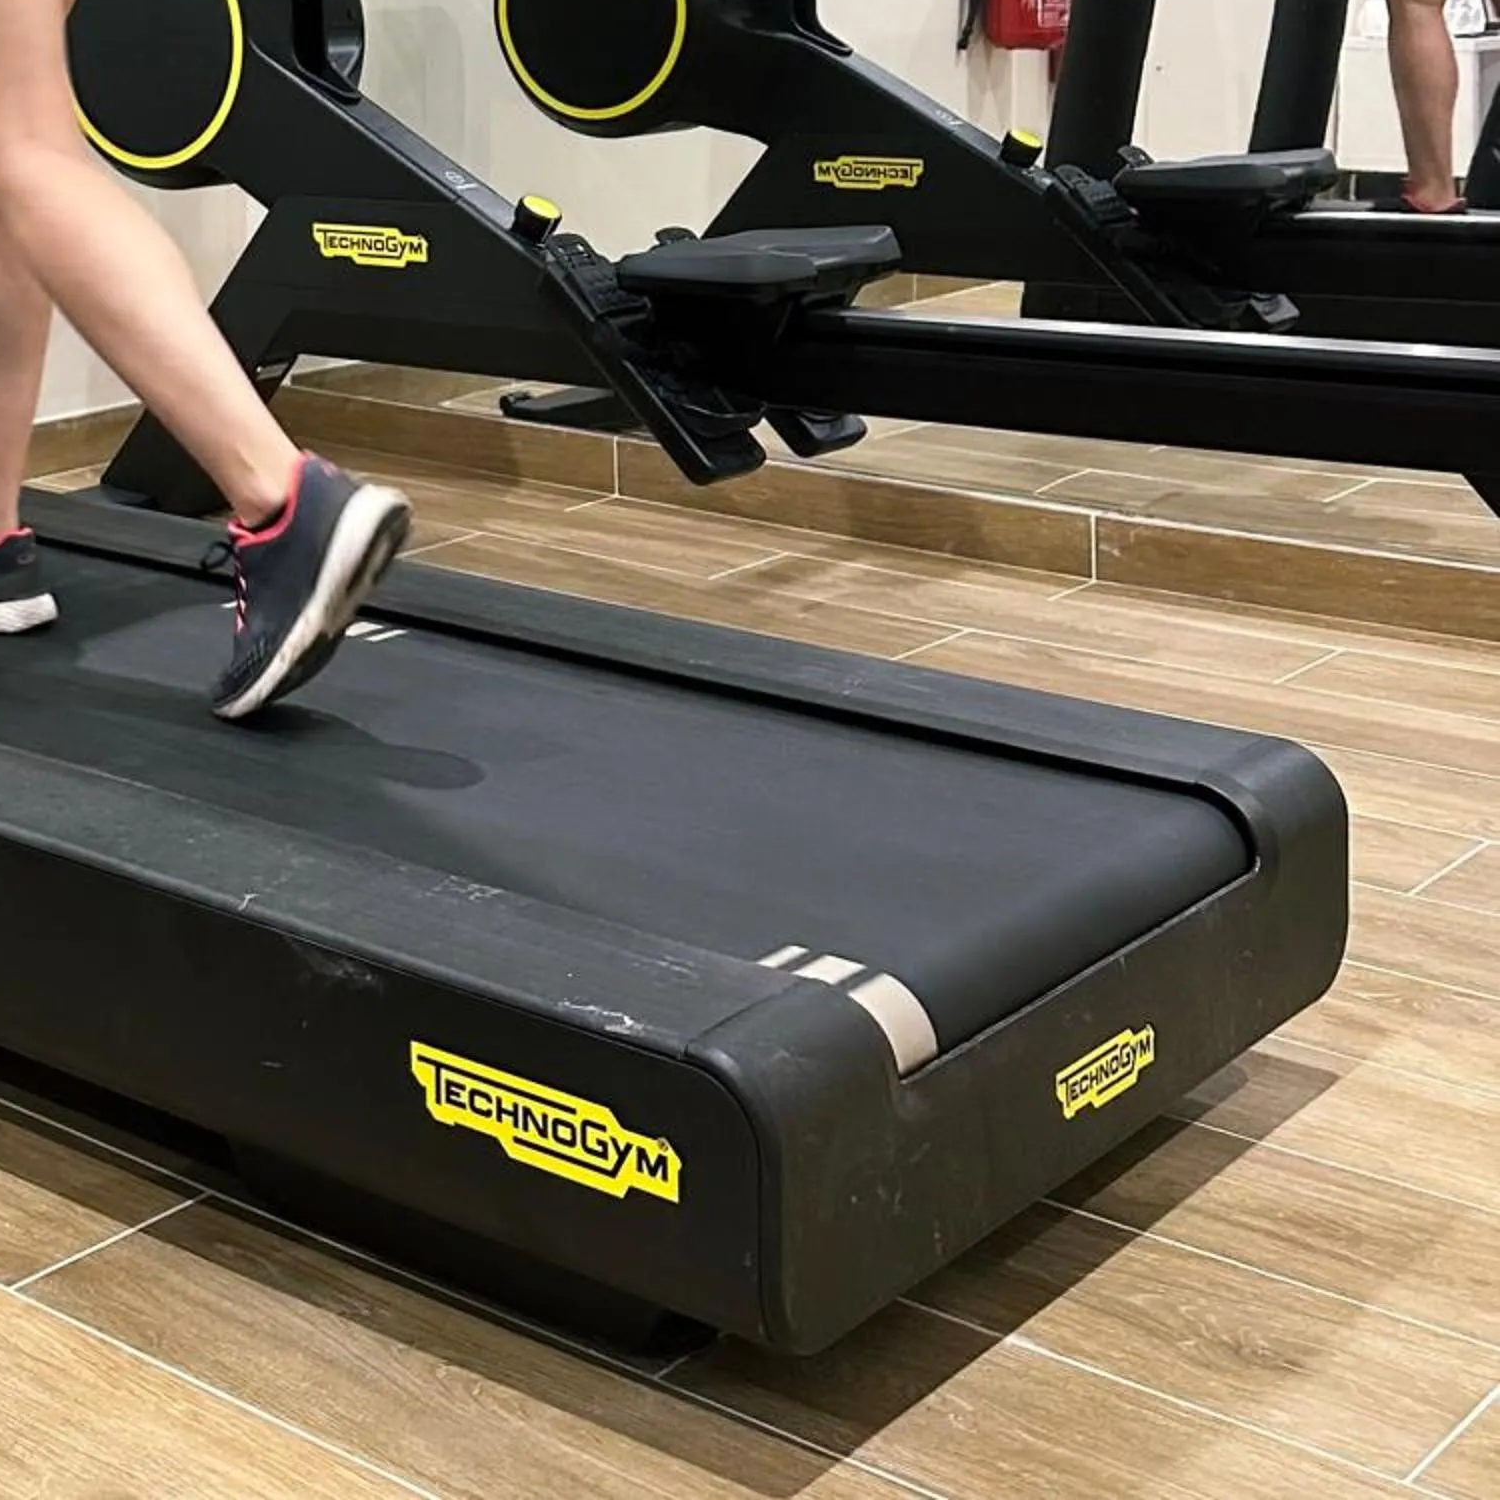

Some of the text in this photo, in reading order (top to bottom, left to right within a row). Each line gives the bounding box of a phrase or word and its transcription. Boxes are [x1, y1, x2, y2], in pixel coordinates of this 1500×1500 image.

[316, 228, 422, 260] TECHNOGYM
[1059, 1035, 1150, 1107] TECHNOGYM
[417, 1054, 668, 1182] TECHNOGYM
